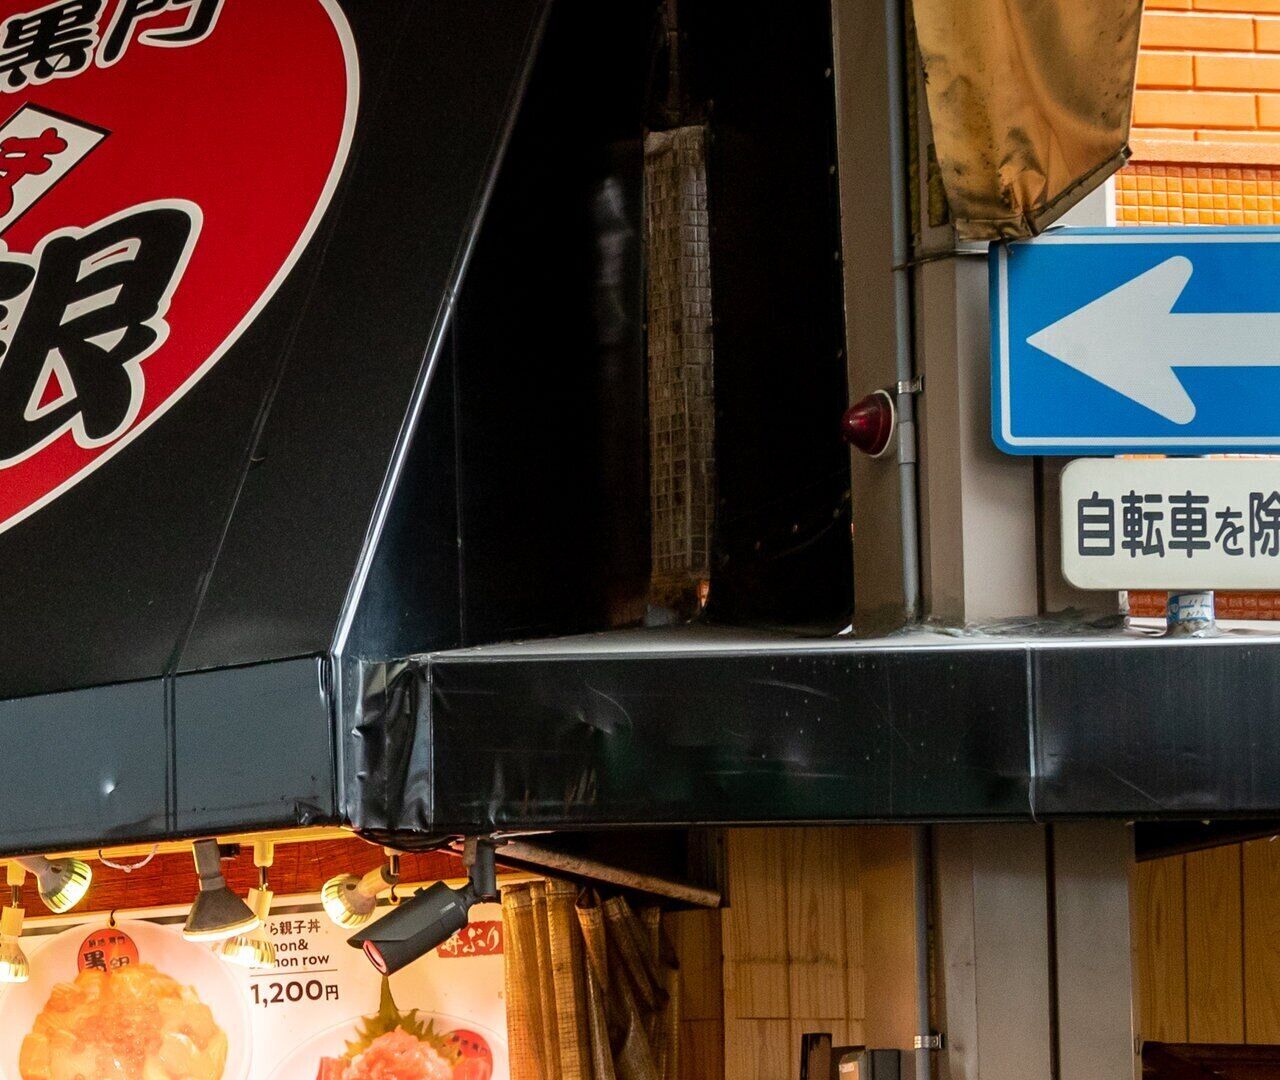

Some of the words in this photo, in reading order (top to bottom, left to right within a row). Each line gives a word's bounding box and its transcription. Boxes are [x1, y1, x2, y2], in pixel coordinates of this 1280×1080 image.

[263, 918, 322, 937] ら親子丼
[302, 954, 331, 966] row
[250, 979, 339, 1008] 1,200円
